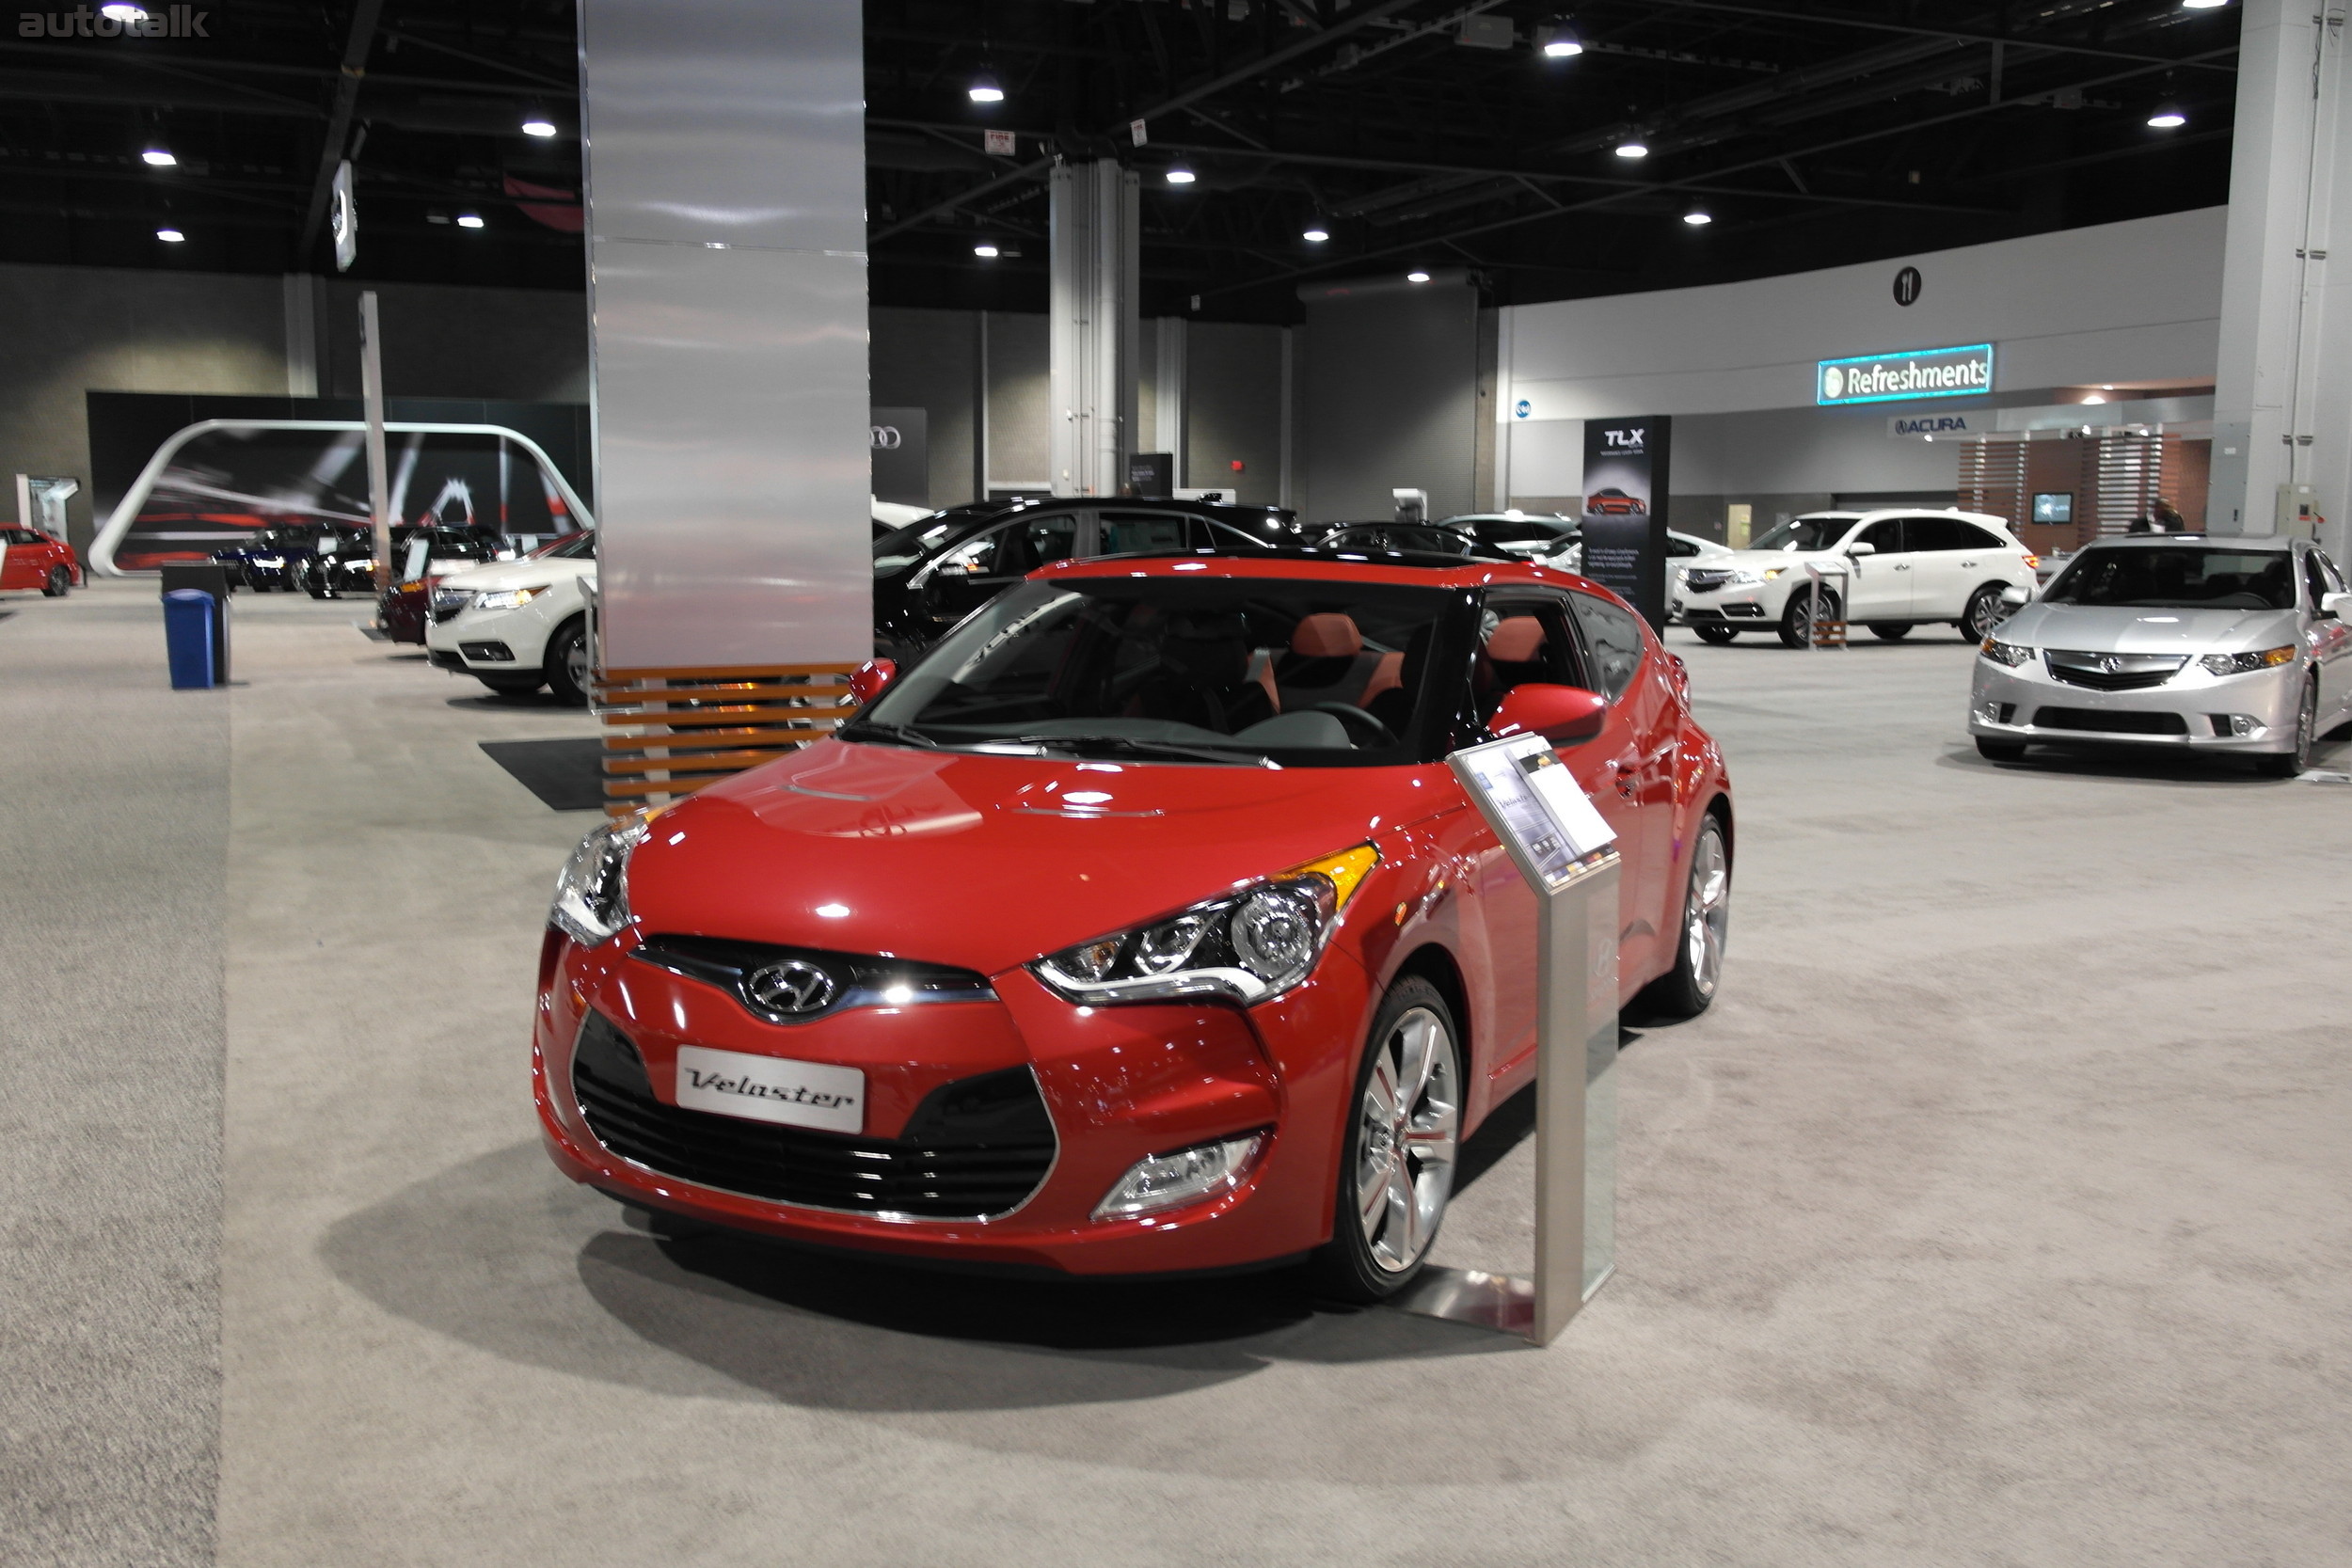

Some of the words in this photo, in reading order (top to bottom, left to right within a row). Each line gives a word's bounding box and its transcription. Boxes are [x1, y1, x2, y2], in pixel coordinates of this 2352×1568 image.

[1848, 359, 1988, 394] Refreshments
[1604, 428, 1645, 447] TLX
[1907, 417, 1966, 434] ACURA
[685, 1068, 855, 1109] Veloster
